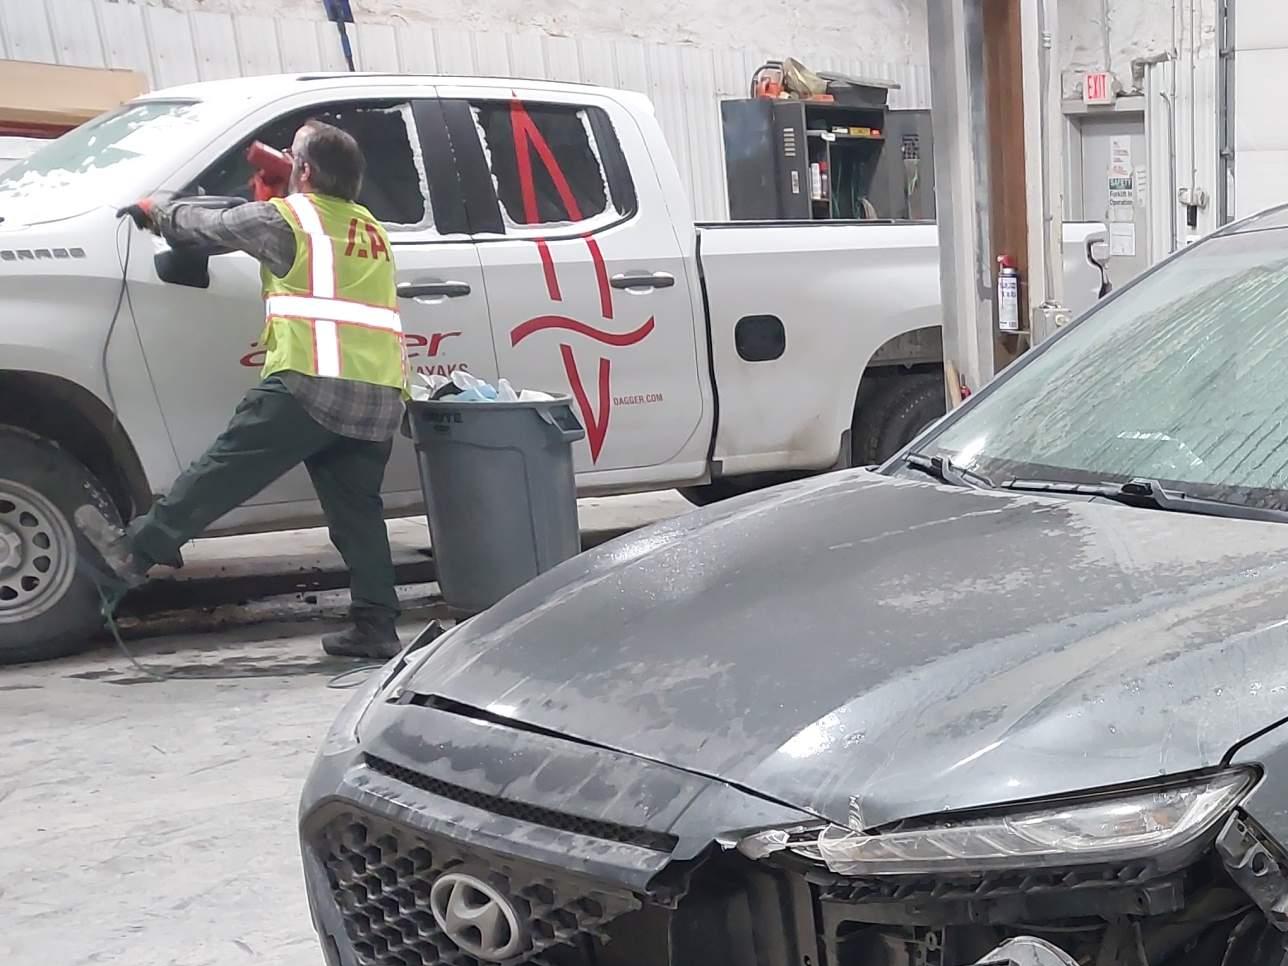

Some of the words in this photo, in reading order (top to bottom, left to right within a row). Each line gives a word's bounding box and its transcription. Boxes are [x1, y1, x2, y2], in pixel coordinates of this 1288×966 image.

[1087, 74, 1106, 99] EXIT
[411, 362, 470, 378] AYAKS
[613, 393, 663, 406] DAGGER.COM
